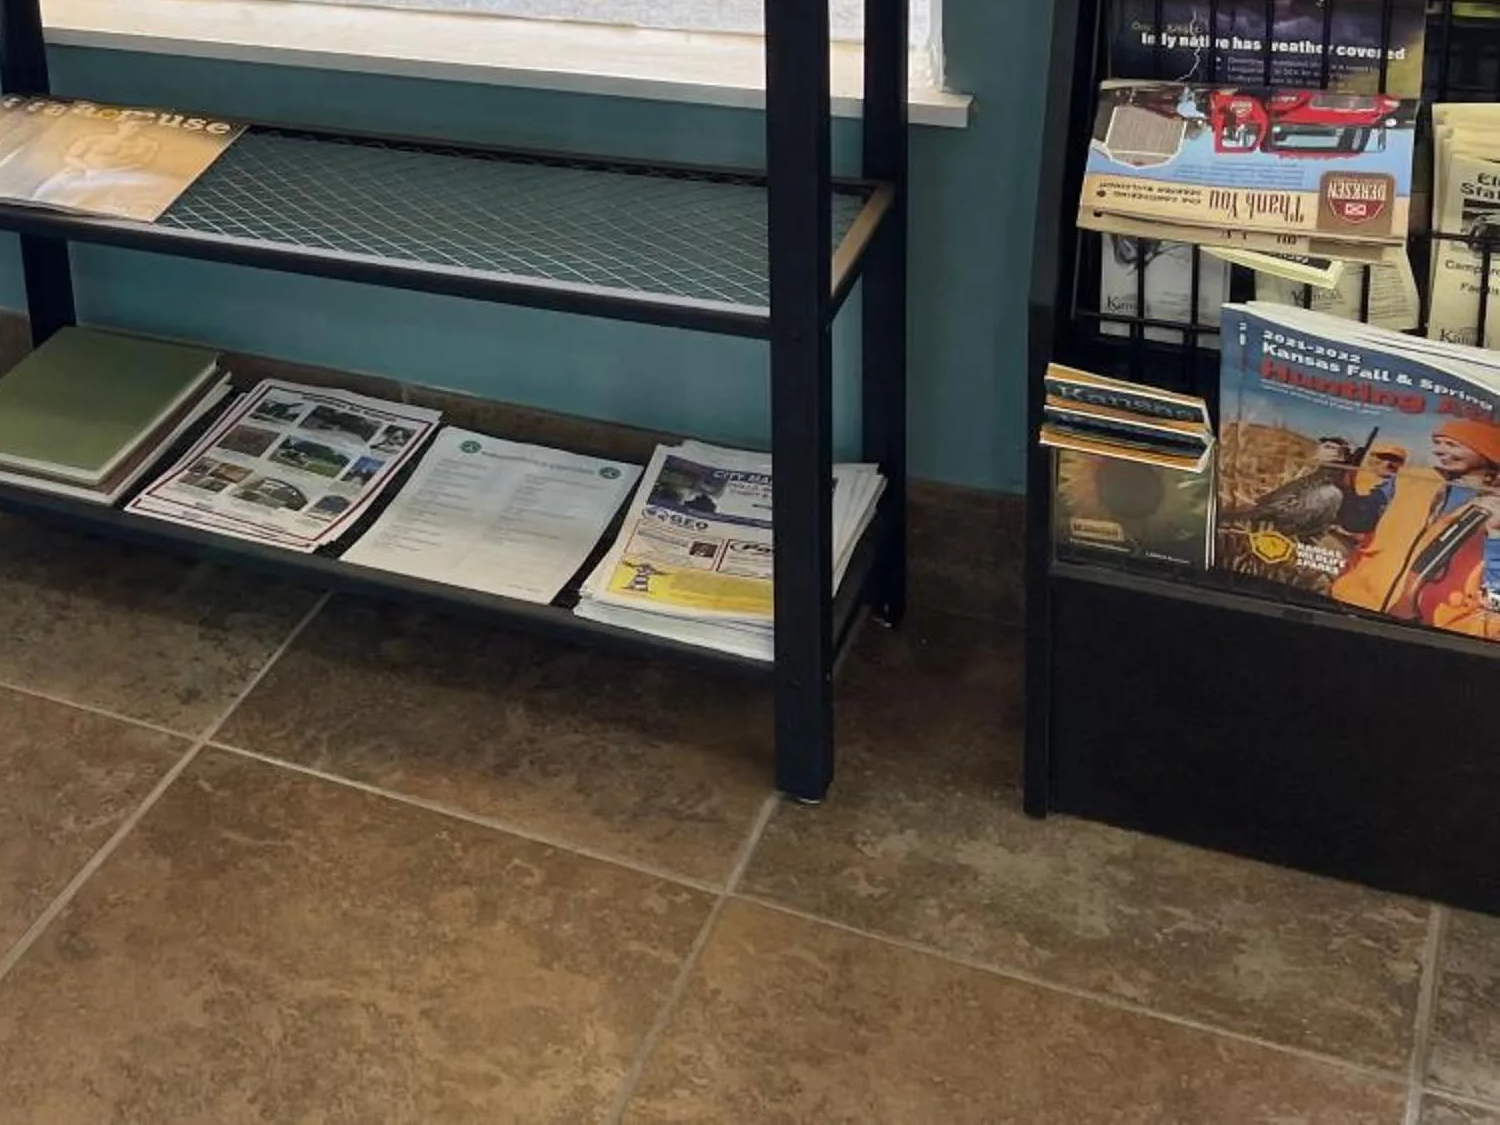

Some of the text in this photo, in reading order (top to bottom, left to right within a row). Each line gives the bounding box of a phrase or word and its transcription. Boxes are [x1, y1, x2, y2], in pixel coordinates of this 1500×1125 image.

[1179, 34, 1230, 49] natie
[1232, 36, 1261, 50] has
[1271, 38, 1334, 54] eather
[1208, 189, 1304, 224] Thank You
[1327, 180, 1387, 200] DERKSEN
[1263, 330, 1362, 364] 2021-2022
[1259, 355, 1428, 415] Hunting
[1262, 342, 1342, 373] Kansas
[1347, 364, 1390, 383] Fall
[1395, 374, 1414, 387] &
[1419, 378, 1494, 412] Spring
